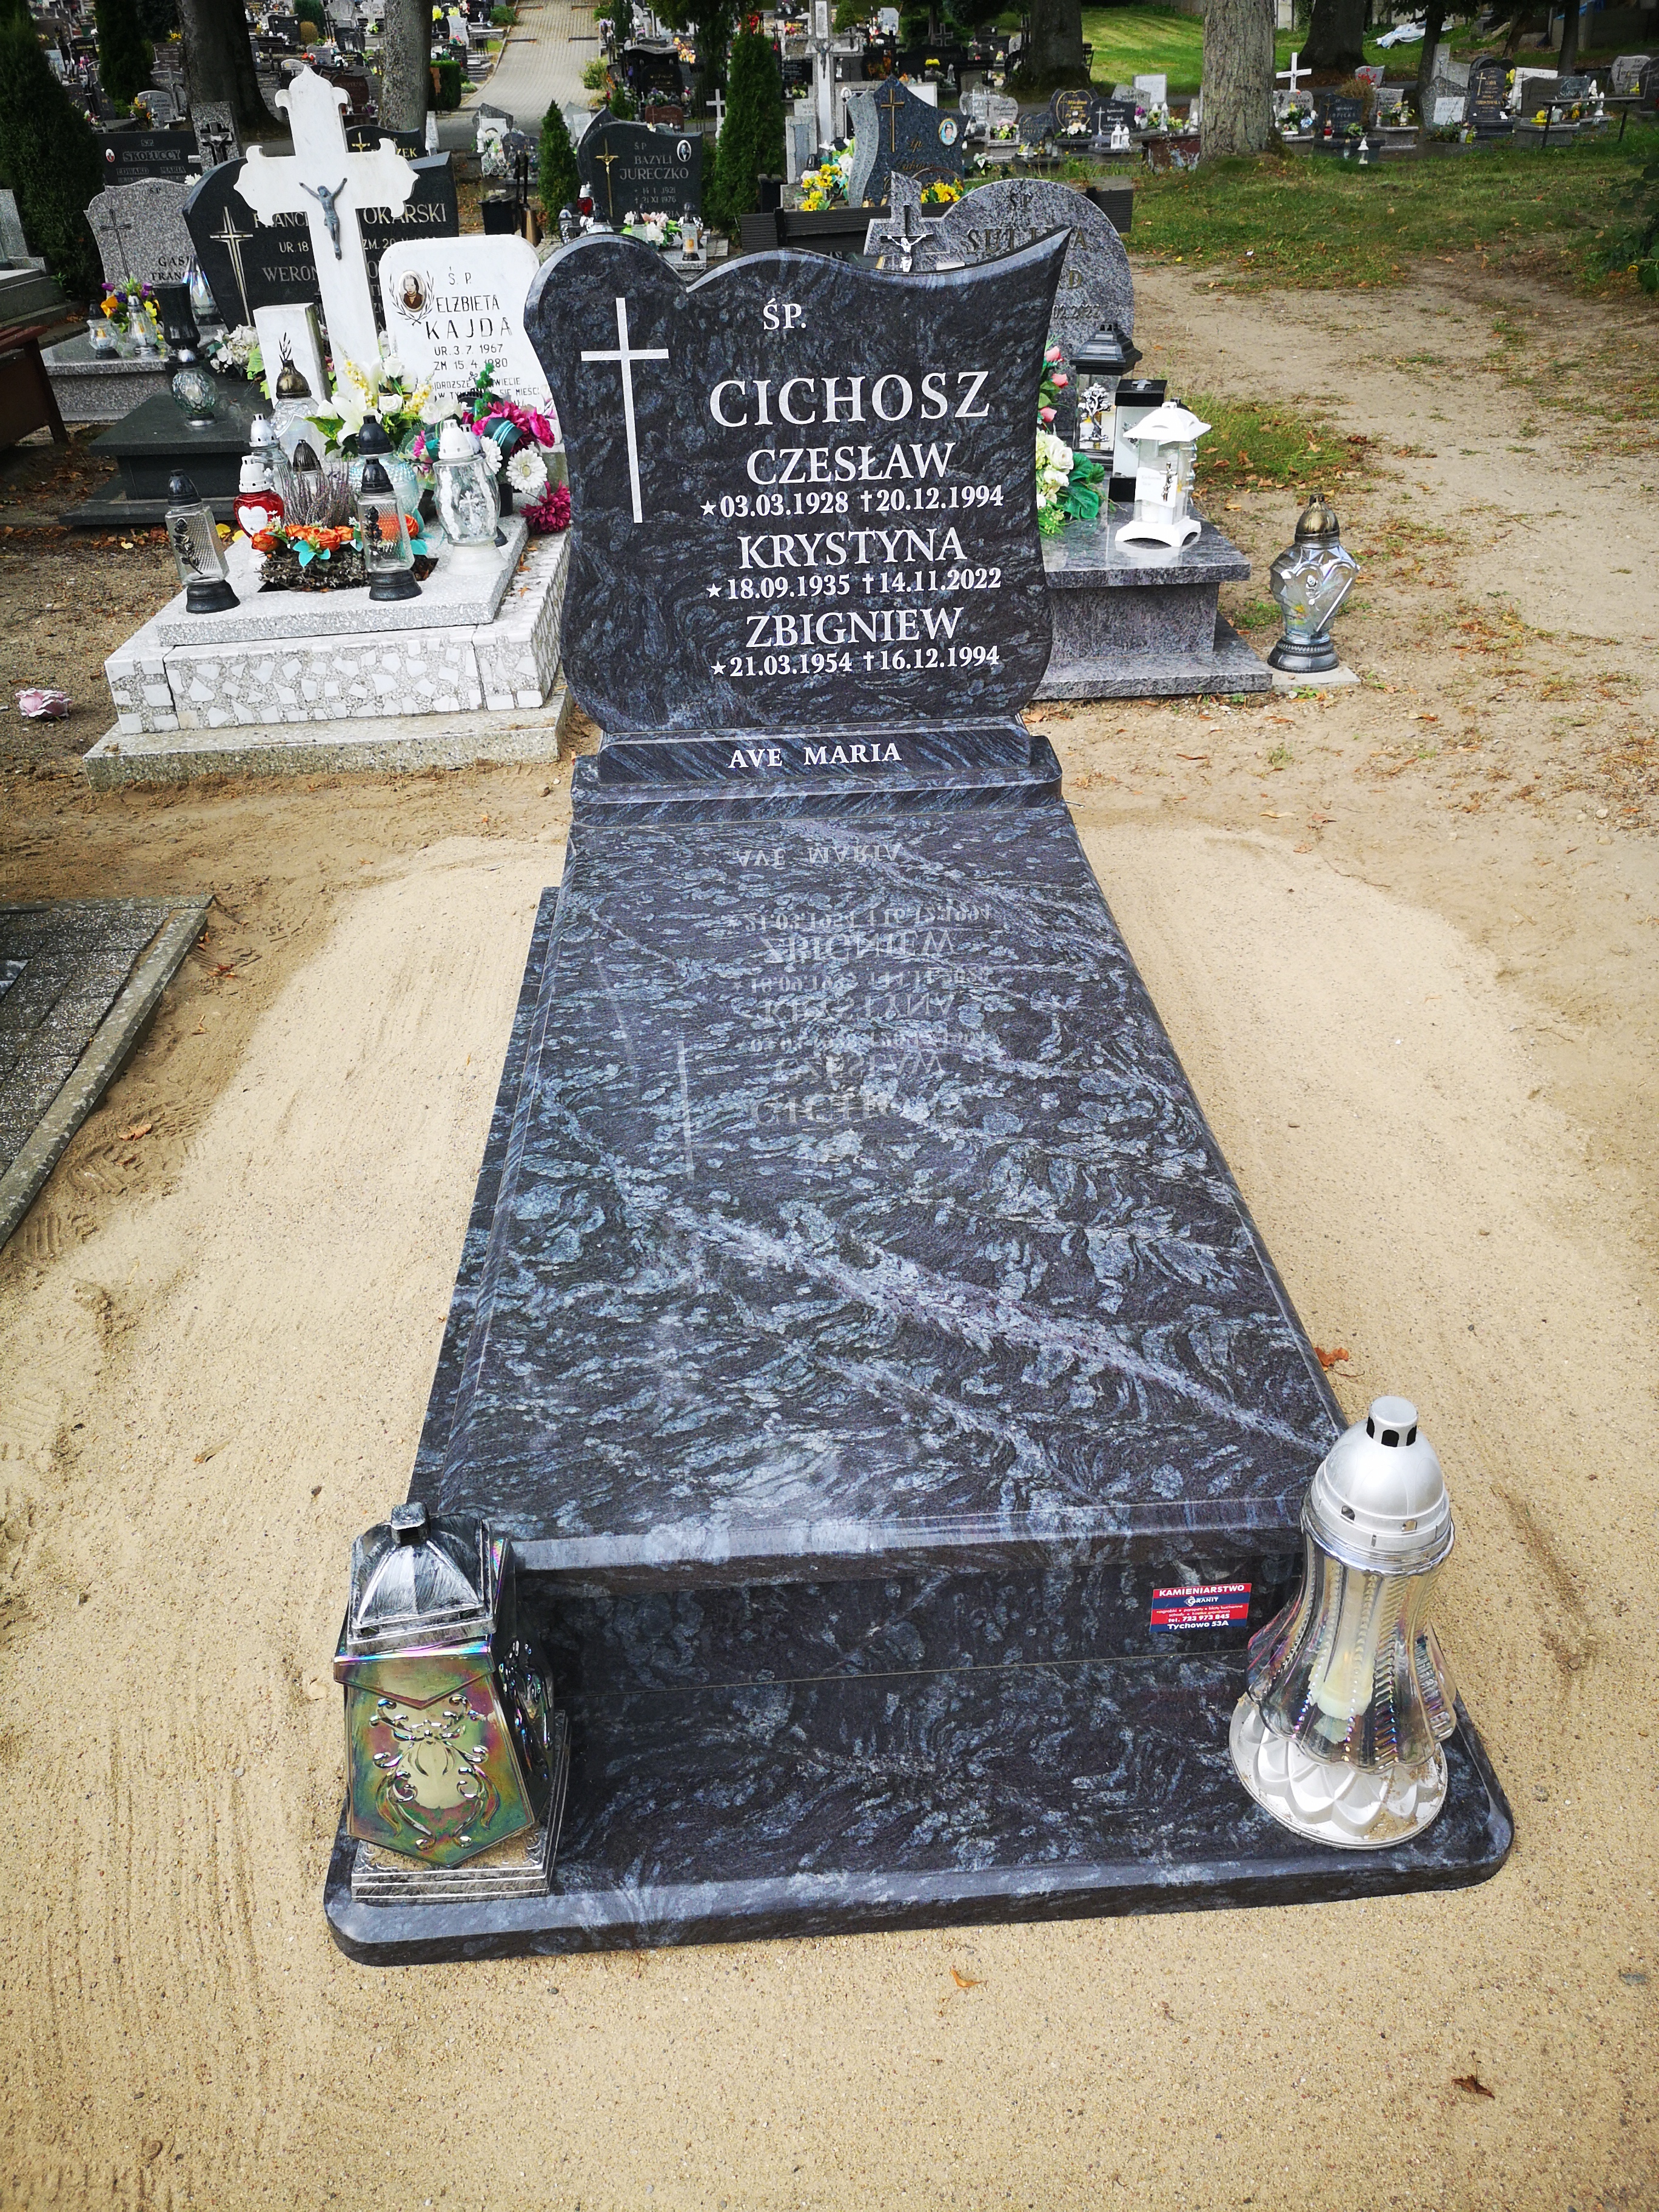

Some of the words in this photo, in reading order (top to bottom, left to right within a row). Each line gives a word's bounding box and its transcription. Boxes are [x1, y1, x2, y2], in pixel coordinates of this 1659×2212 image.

[122, 149, 181, 163] SKOŁUCCY
[634, 155, 672, 165] BAZYLI
[116, 167, 149, 175] EDWARD
[620, 167, 689, 180] JURECZKO
[425, 317, 513, 340] KAJDA
[709, 370, 990, 428] CICHOSZ
[746, 441, 957, 486] CZESŁAW
[720, 490, 849, 518] 03.03.1928
[876, 484, 1005, 512] 20.12.1994
[737, 526, 968, 570] KRYSTYNA
[728, 573, 850, 600] 18.09.1935
[879, 567, 1002, 594] 14.11.2022
[745, 606, 965, 648] ZBIGNIEW
[729, 651, 853, 677] 21.03.1954
[880, 645, 1000, 671] 16.12.1994
[728, 748, 783, 769] AVE
[803, 742, 902, 766] MARIA
[1159, 1584, 1245, 1597] KAMIENIARSTWO
[1167, 1622, 1210, 1631] Tychowo
